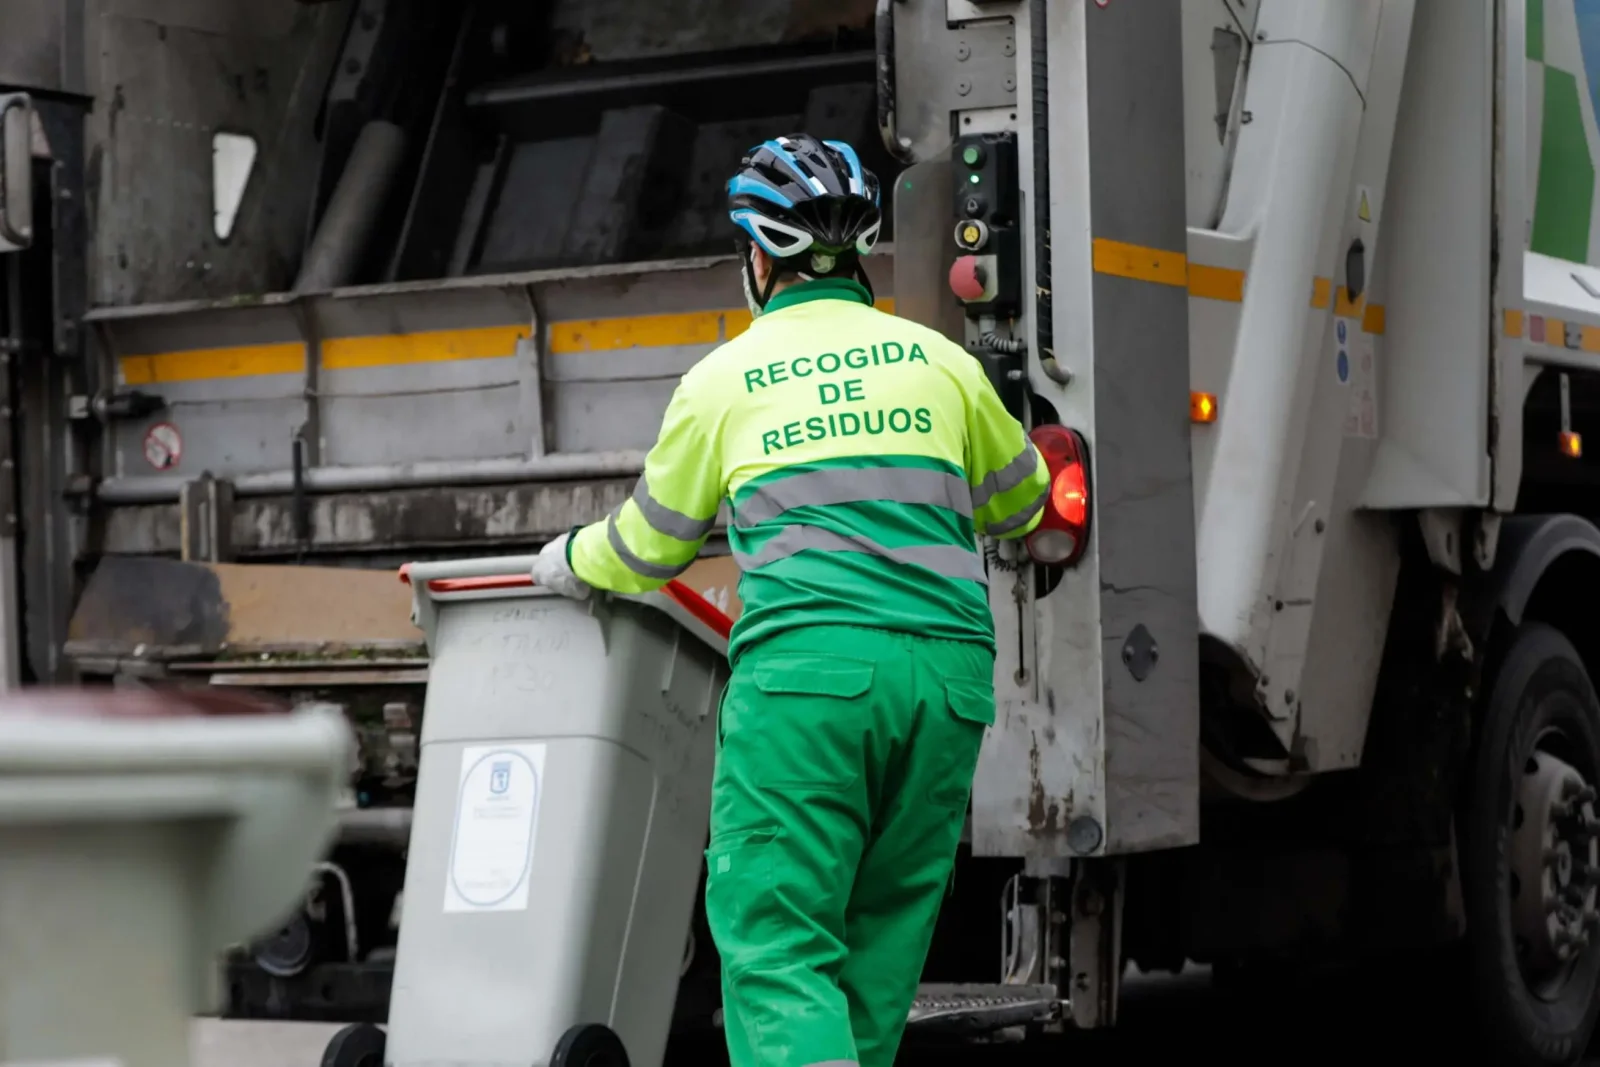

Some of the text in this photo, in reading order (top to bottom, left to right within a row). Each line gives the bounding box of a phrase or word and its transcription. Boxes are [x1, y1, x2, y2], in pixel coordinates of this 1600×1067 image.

[744, 341, 929, 393] RECOGIDA
[818, 379, 866, 405] DE
[762, 408, 932, 455] RESIDUOS
